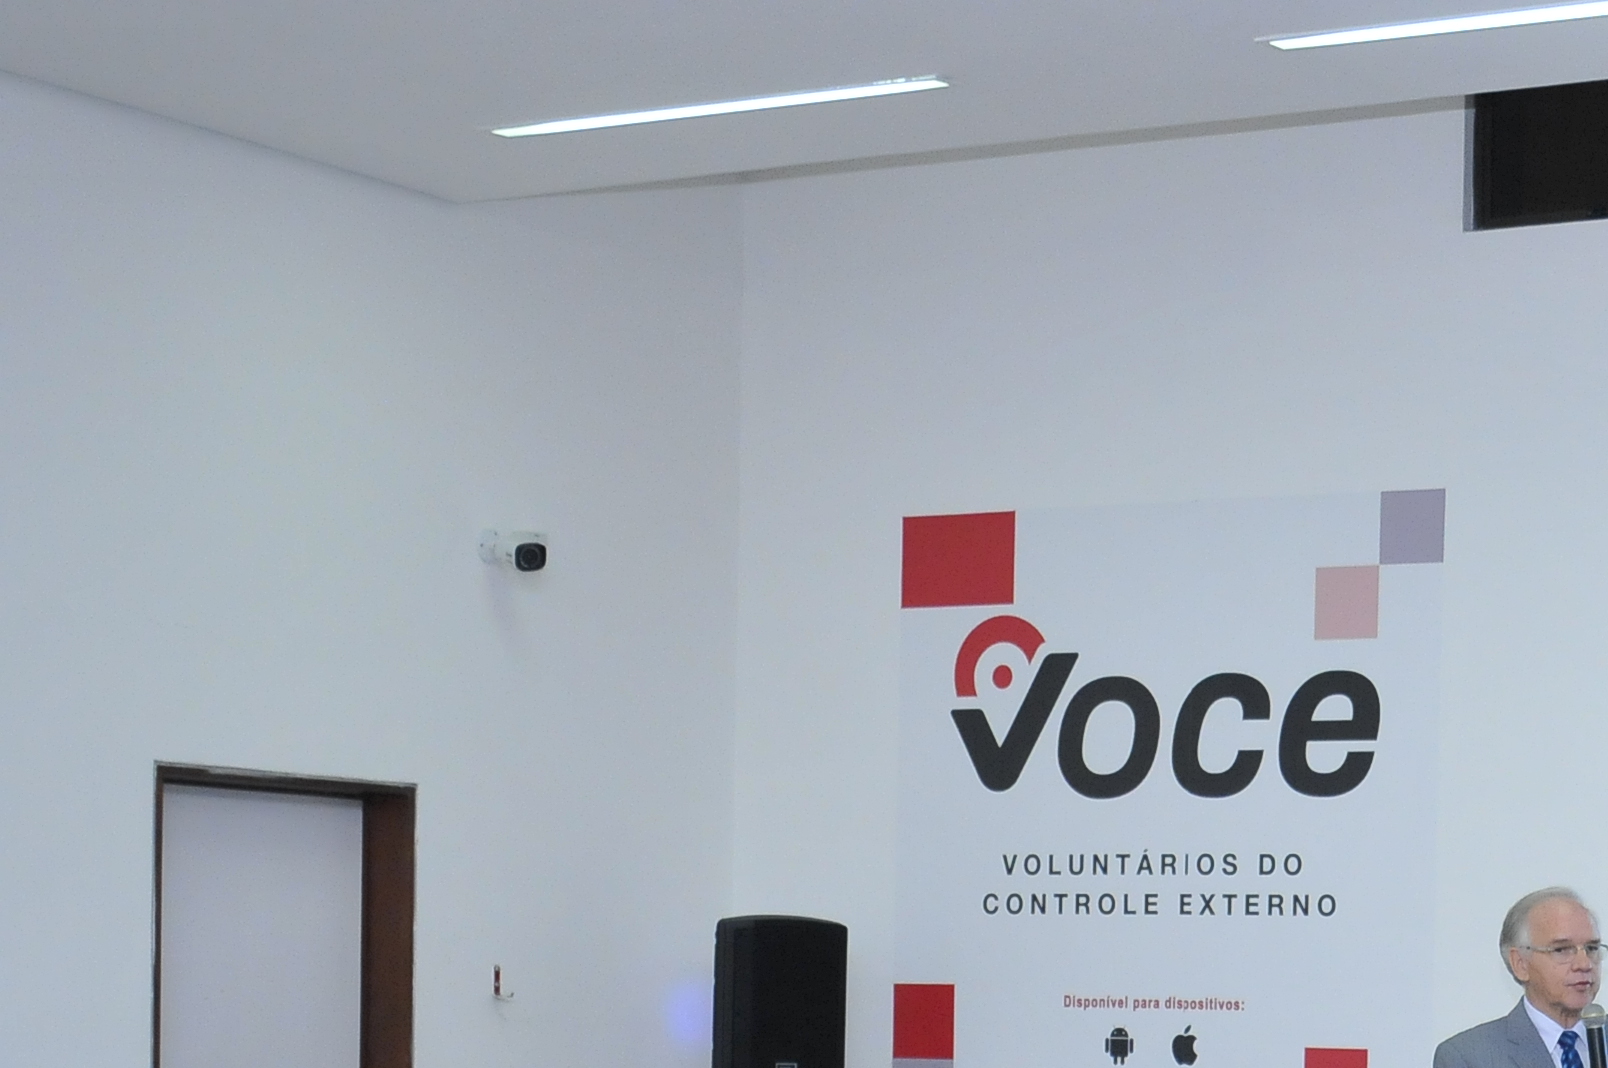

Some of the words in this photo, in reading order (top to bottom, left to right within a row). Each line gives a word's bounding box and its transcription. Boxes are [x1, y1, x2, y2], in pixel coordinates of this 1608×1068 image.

[1001, 849, 1239, 877] VOLUNTÁRIOS
[1258, 852, 1304, 877] DO
[982, 892, 1160, 917] CONTROLE
[1178, 893, 1338, 918] EXTERNO
[1063, 994, 1128, 1011] Disponível
[1132, 997, 1160, 1012] para
[1164, 996, 1246, 1013] dispositivos:
